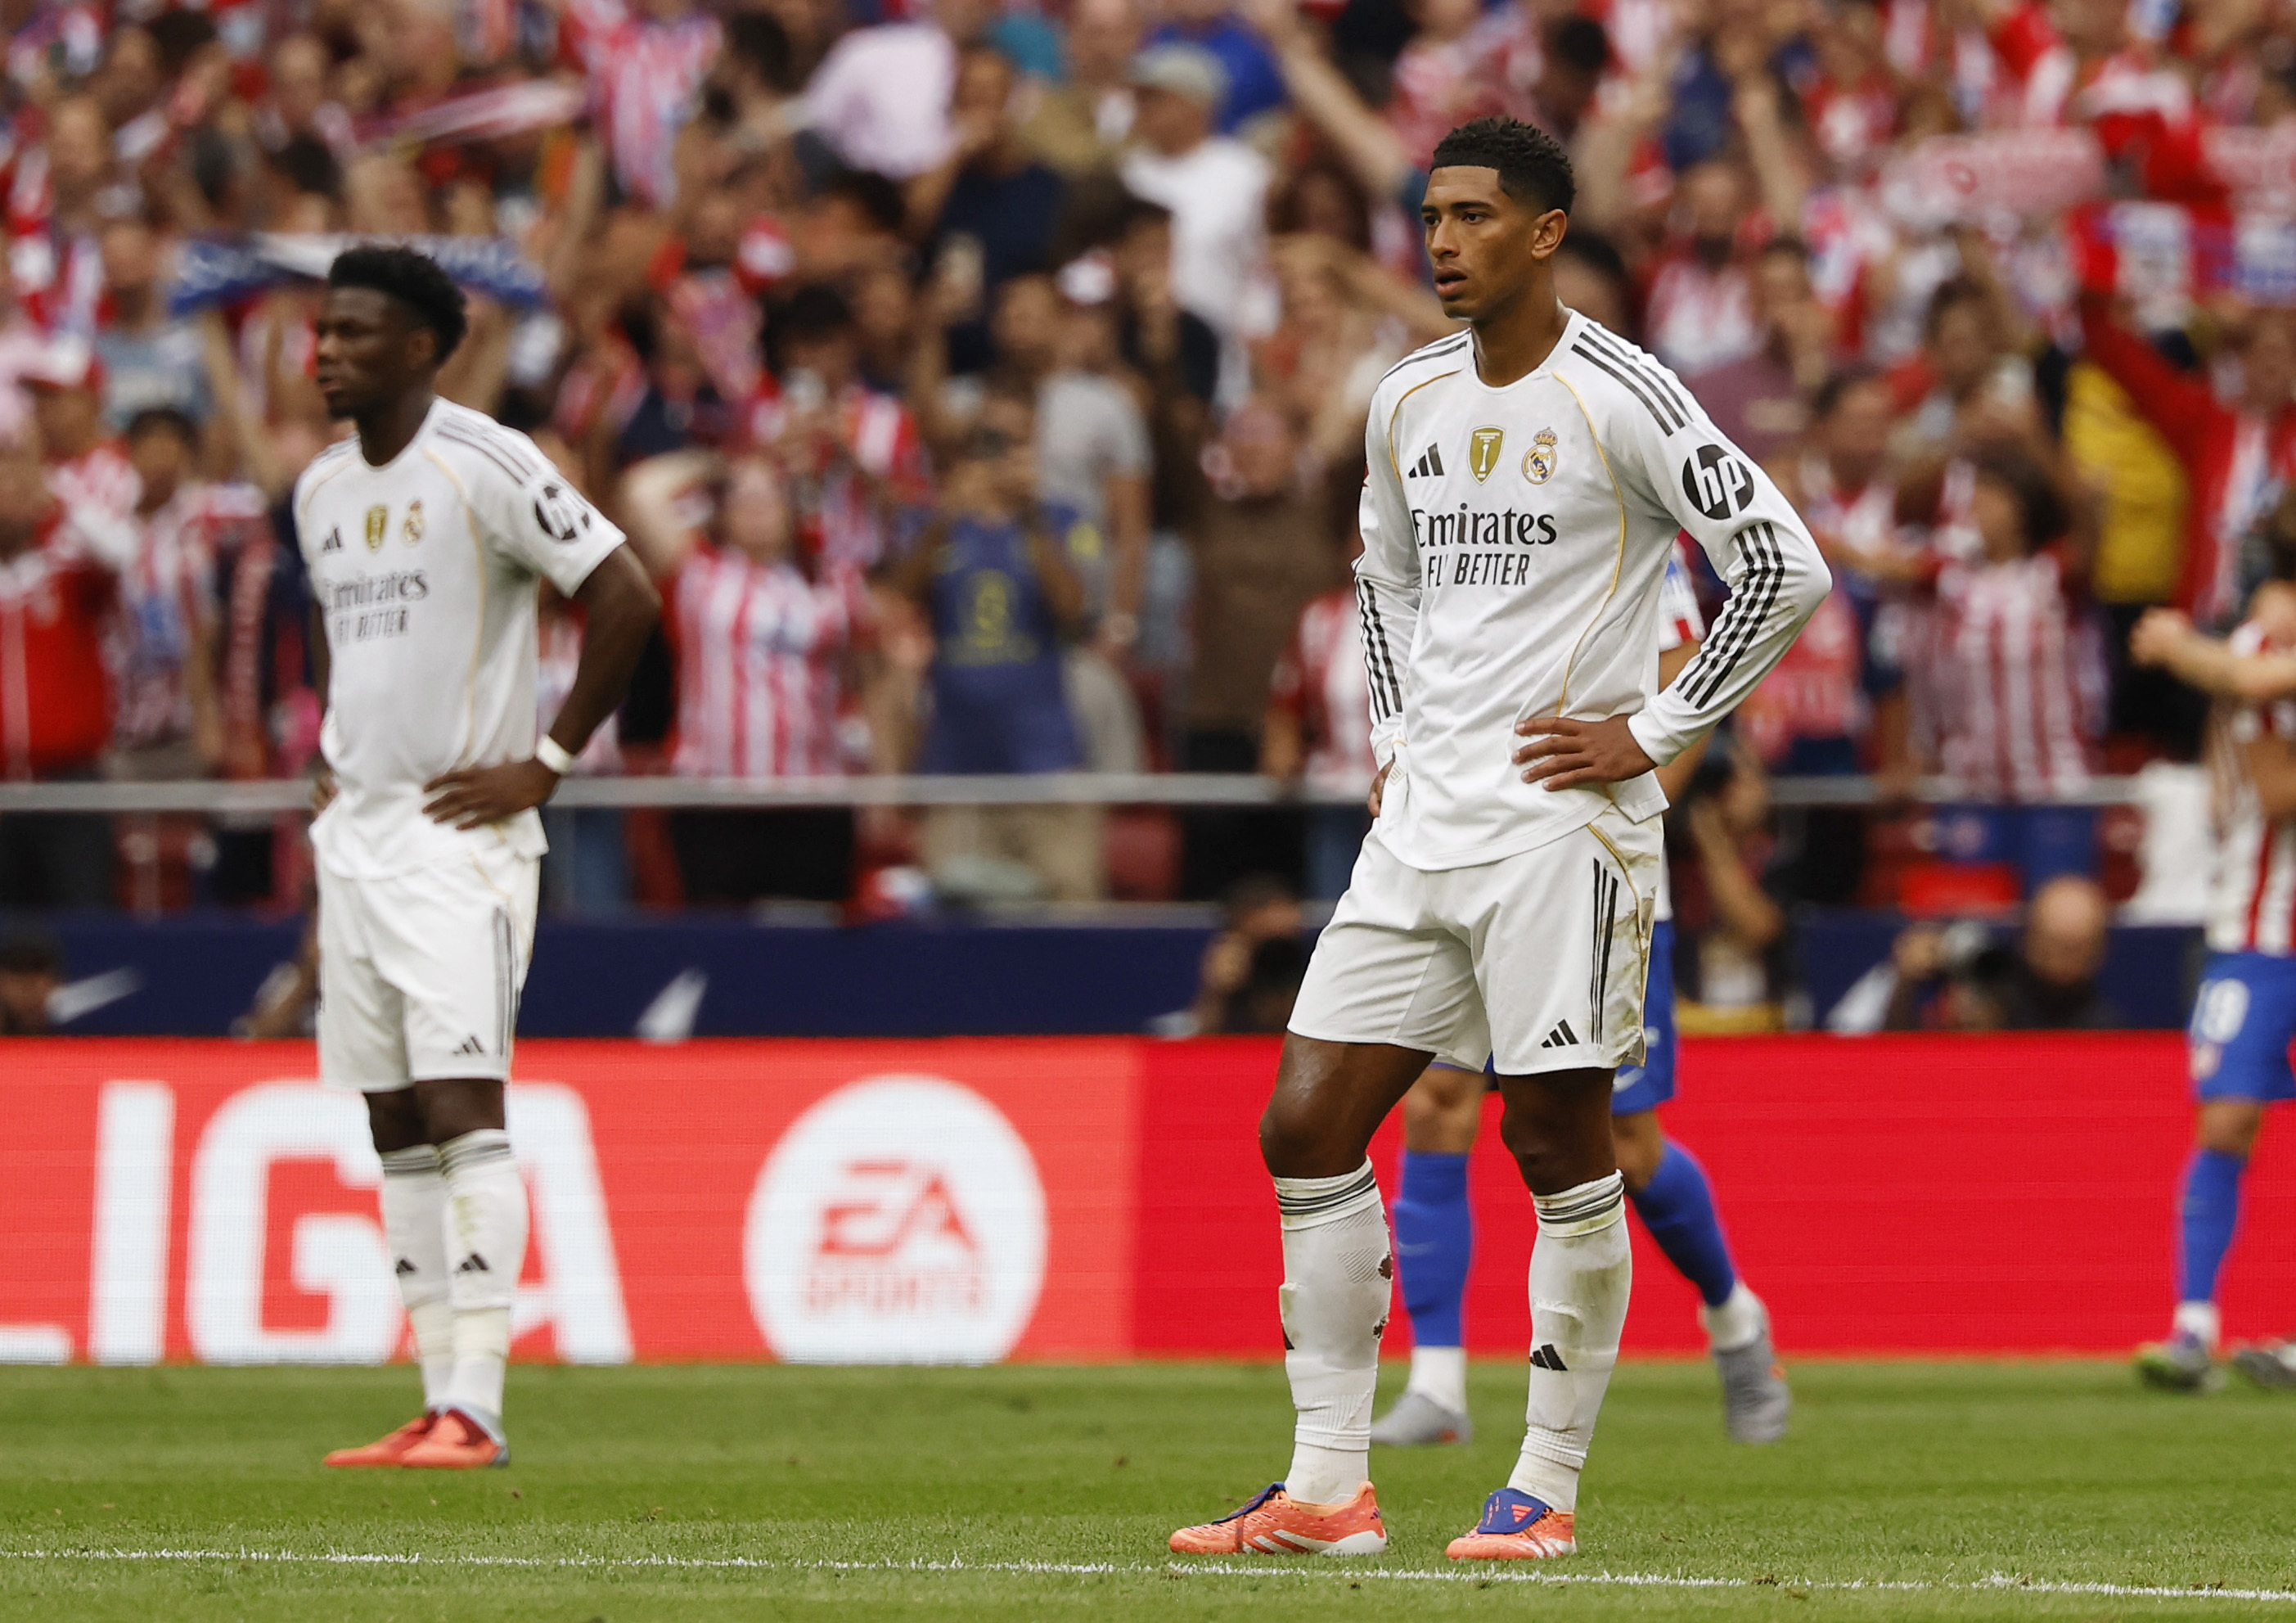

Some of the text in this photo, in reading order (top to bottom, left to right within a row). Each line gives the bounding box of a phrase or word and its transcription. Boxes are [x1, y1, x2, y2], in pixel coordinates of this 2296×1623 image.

[1686, 449, 1748, 517] hp
[1411, 502, 1557, 548] Emirates
[1427, 552, 1531, 588] FL BETTER
[818, 1160, 979, 1257] EA
